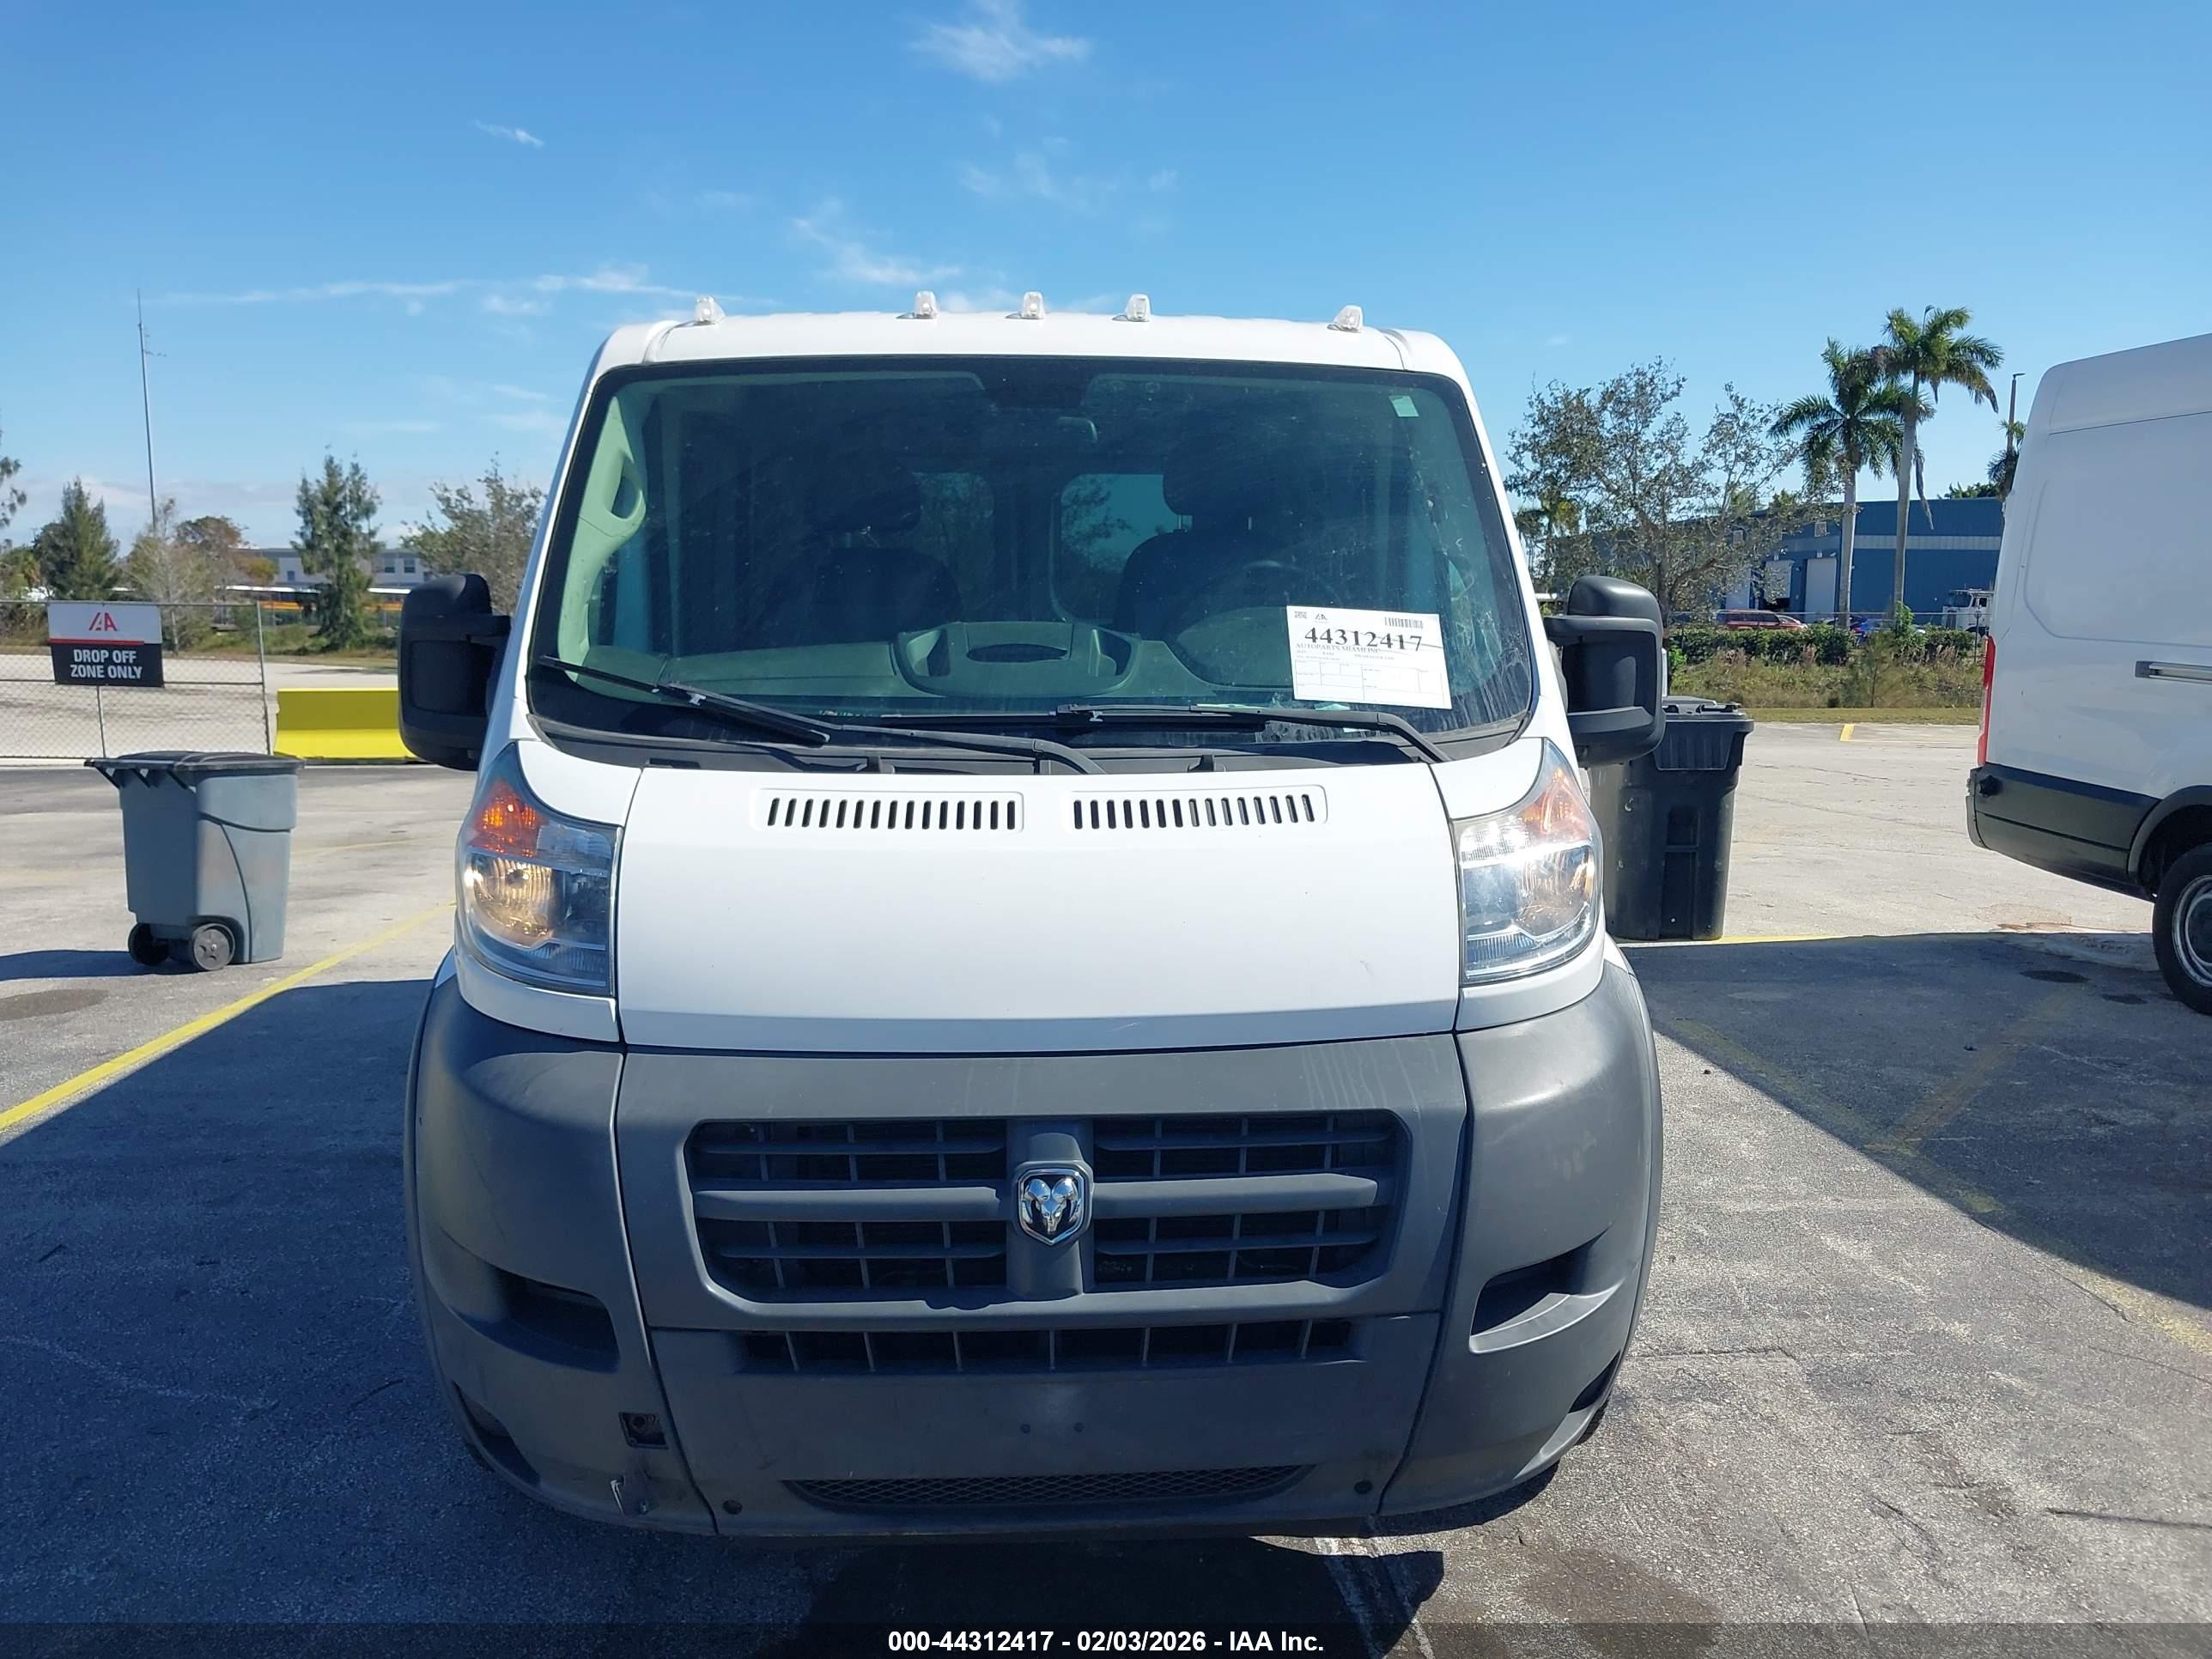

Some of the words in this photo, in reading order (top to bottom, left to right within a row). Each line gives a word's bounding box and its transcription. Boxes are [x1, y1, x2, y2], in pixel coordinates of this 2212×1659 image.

[1304, 627, 1423, 652] 44312417
[73, 648, 109, 663] DROP
[112, 650, 137, 664] OFF
[70, 664, 105, 678] ZONE
[107, 665, 143, 679] ONLY
